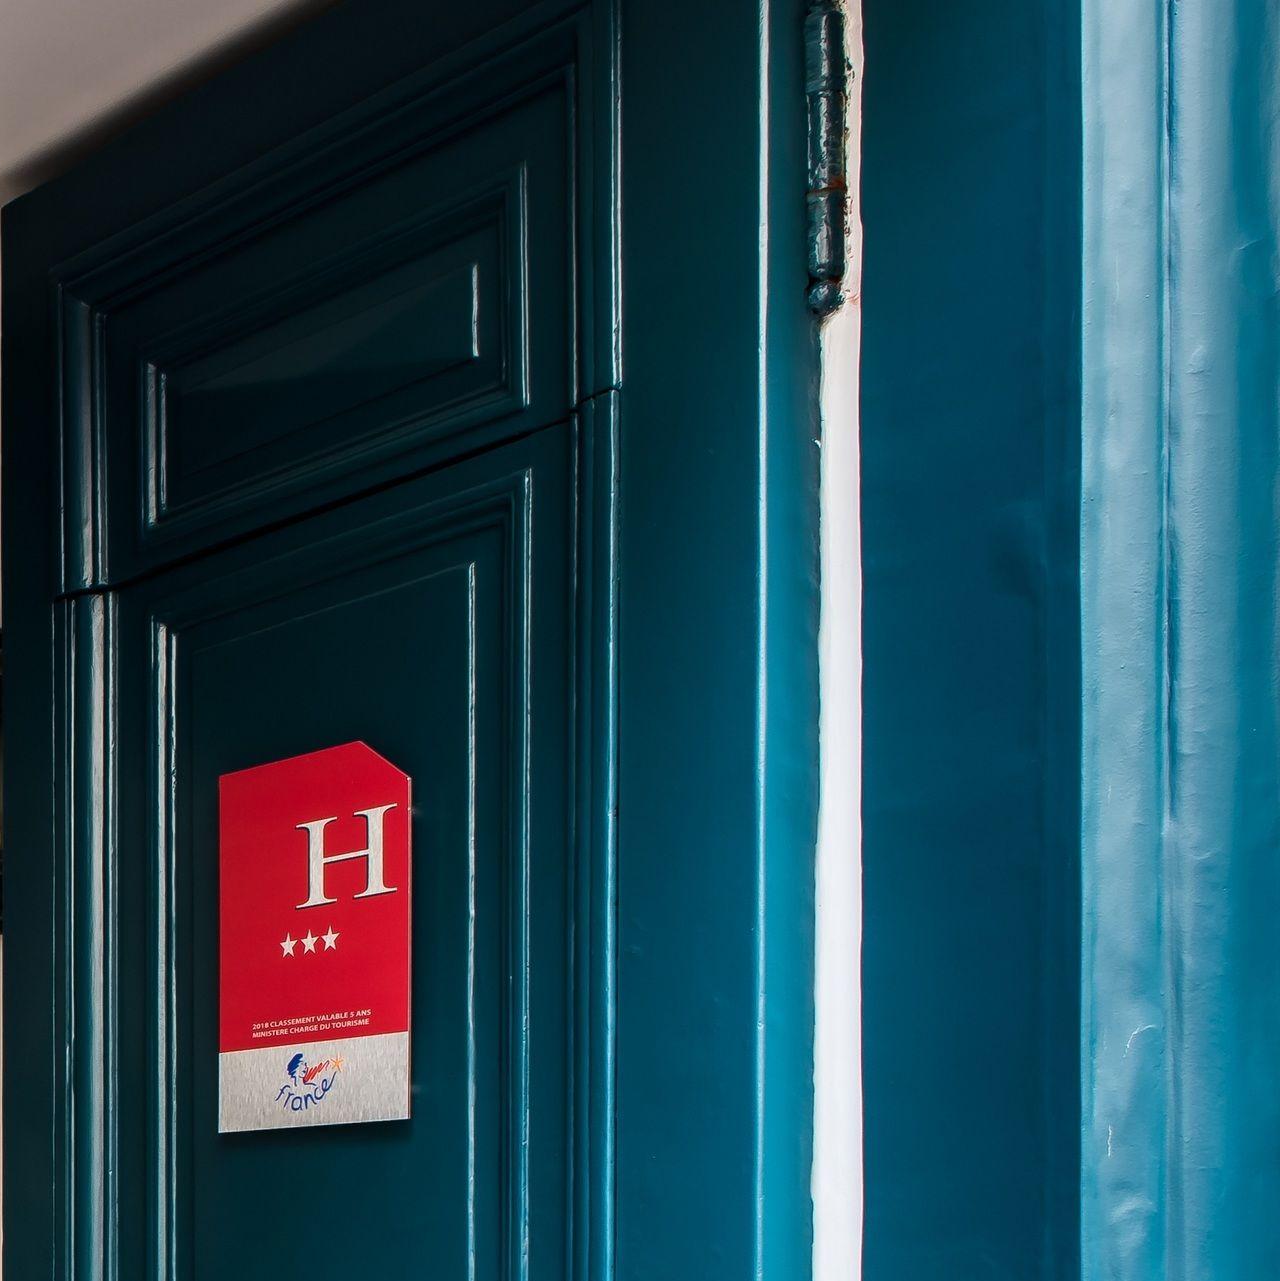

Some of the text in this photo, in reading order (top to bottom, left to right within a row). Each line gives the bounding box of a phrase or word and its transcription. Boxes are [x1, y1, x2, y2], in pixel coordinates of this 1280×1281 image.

[296, 802, 398, 909] H
[252, 1022, 269, 1030] 2018
[270, 1016, 315, 1028] CLASSEMENT
[316, 1011, 348, 1022] VALABLE
[356, 1009, 371, 1017] ANS
[252, 1028, 289, 1038] MINISTERE
[320, 1022, 331, 1030] DU
[331, 1018, 370, 1029] TOURISME
